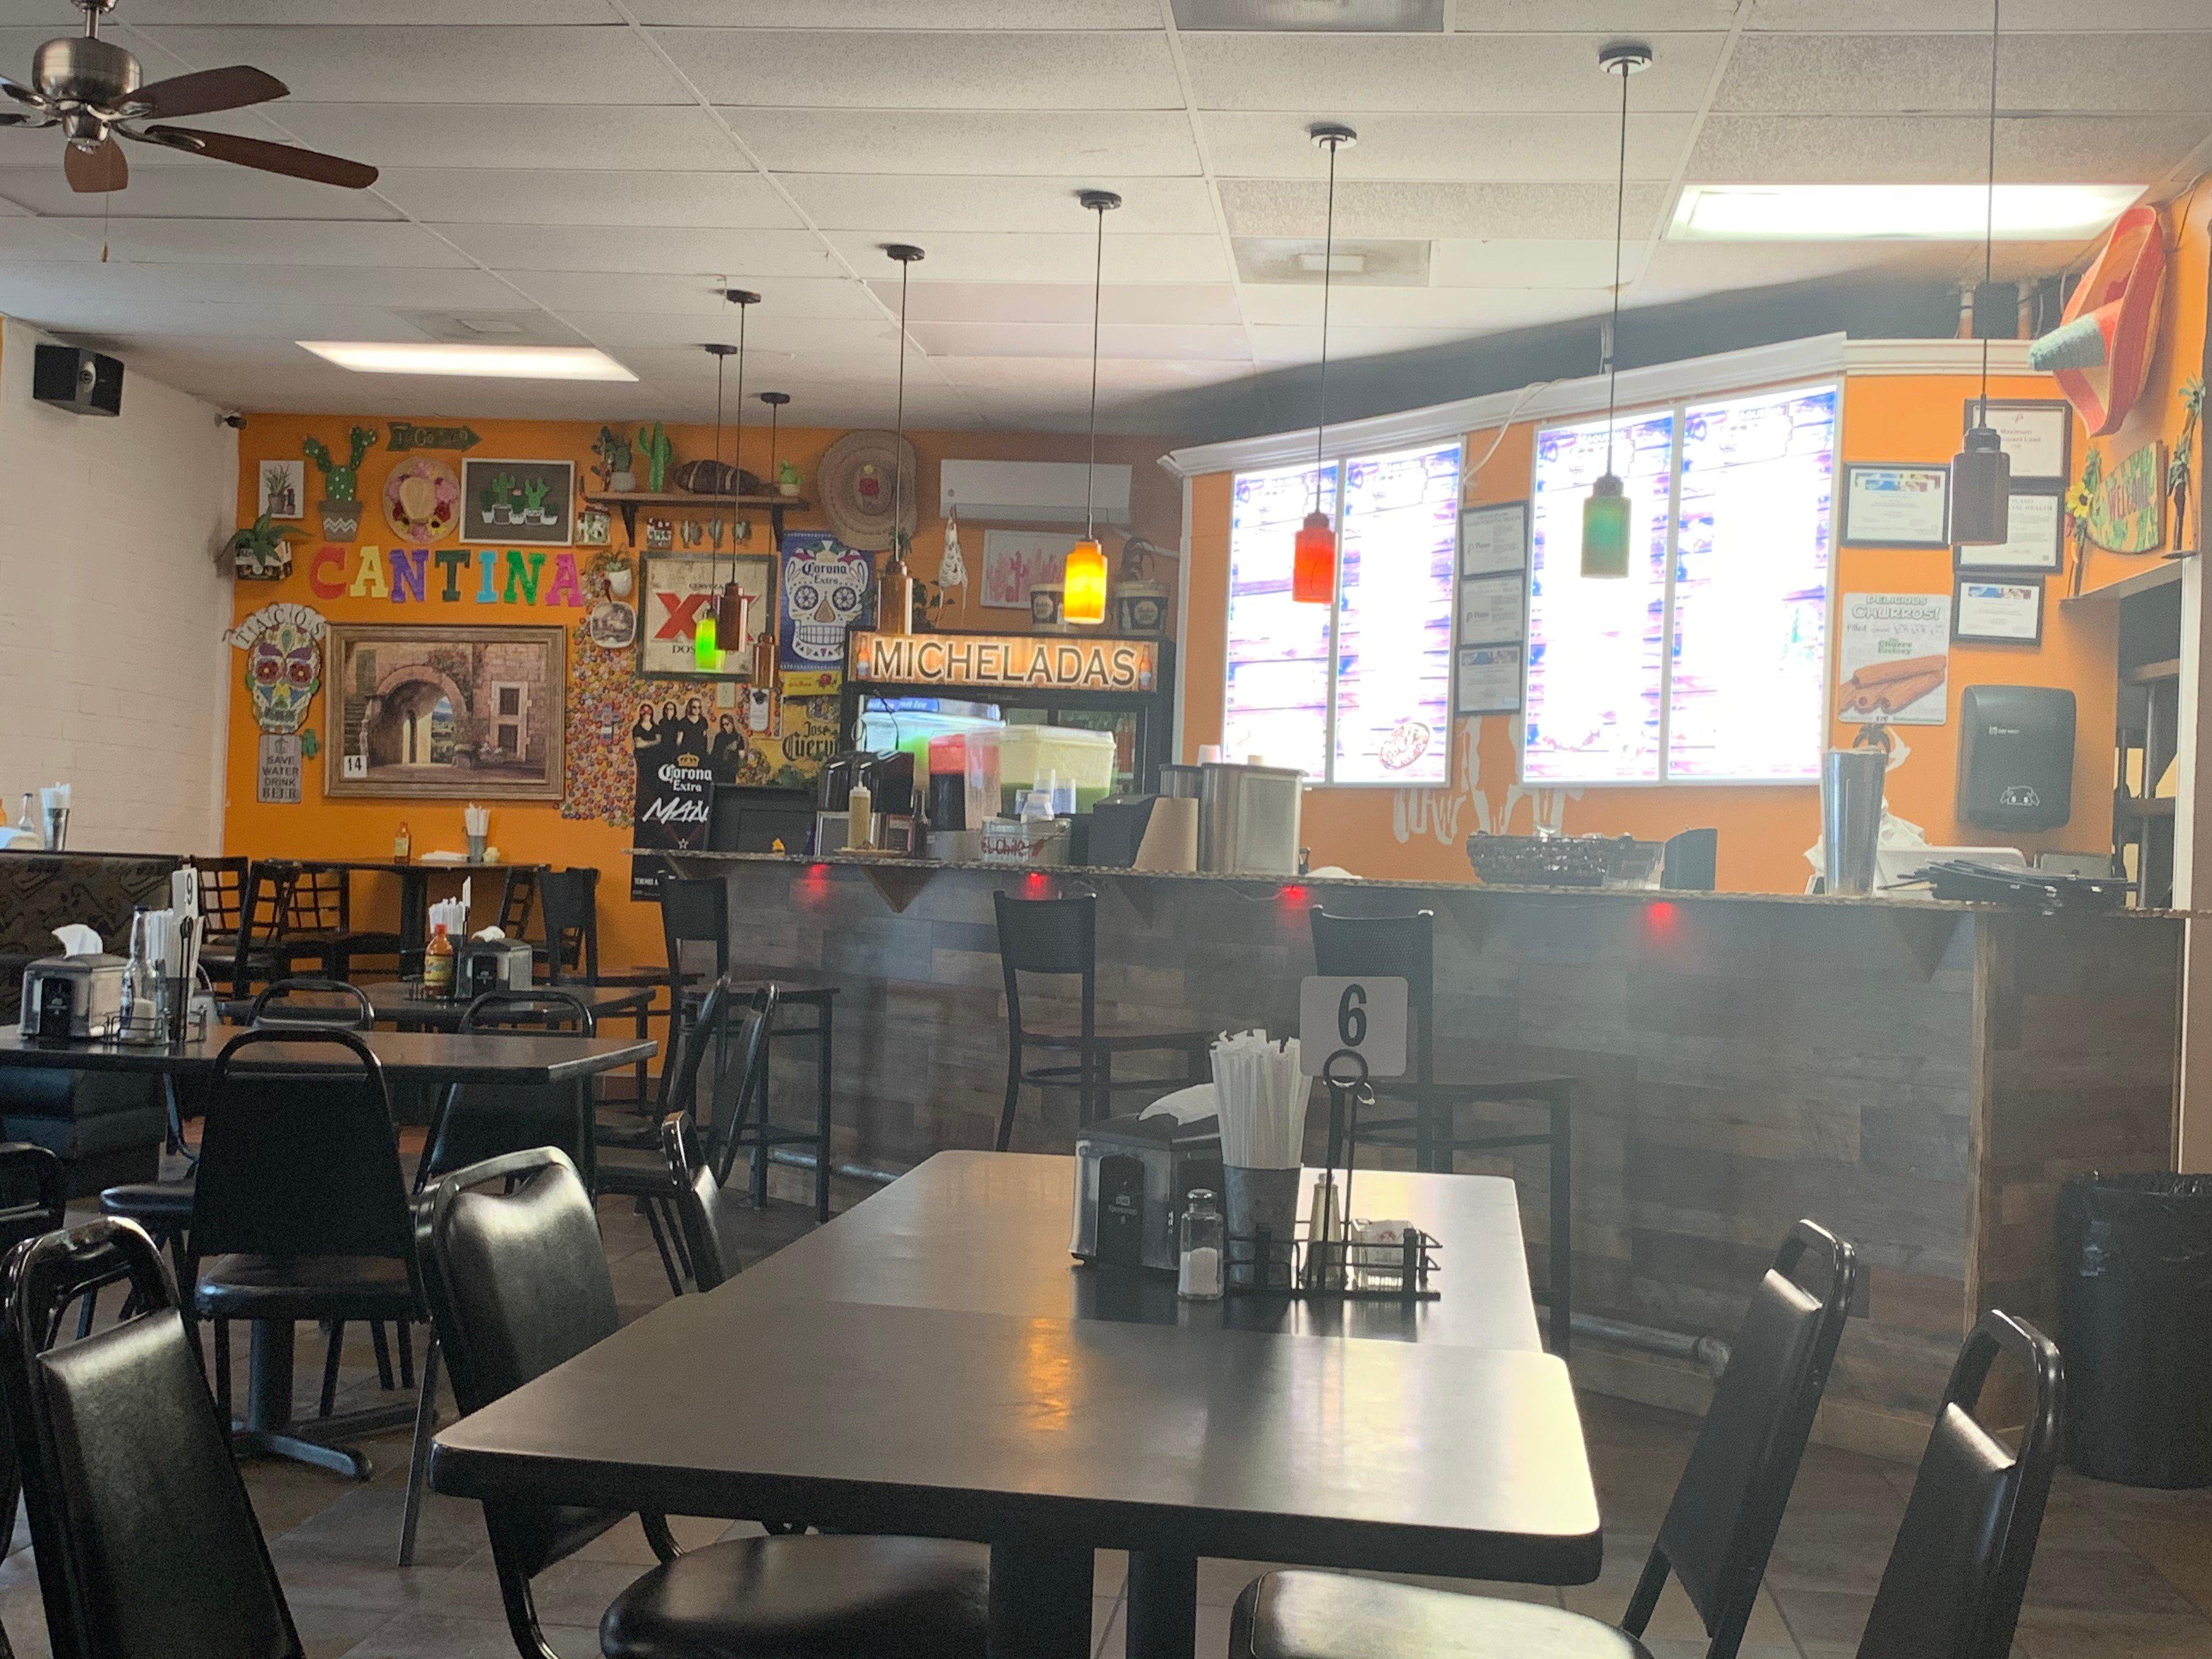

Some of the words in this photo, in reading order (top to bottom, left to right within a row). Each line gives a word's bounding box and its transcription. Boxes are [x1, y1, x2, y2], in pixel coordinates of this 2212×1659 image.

[309, 545, 584, 607] CANTINA
[802, 562, 847, 575] Corona
[1852, 604, 1941, 620] CHURROS!
[235, 608, 324, 645] TACOS
[872, 640, 1136, 687] MICHELADAS
[266, 756, 295, 765] SAVE
[347, 757, 363, 772] 14
[262, 766, 299, 776] WATER
[658, 764, 712, 783] Corona
[264, 777, 296, 786] DRINK
[673, 779, 702, 792] Extra
[262, 787, 297, 799] BEER
[187, 873, 193, 905] 9
[1338, 983, 1367, 1047] 6
